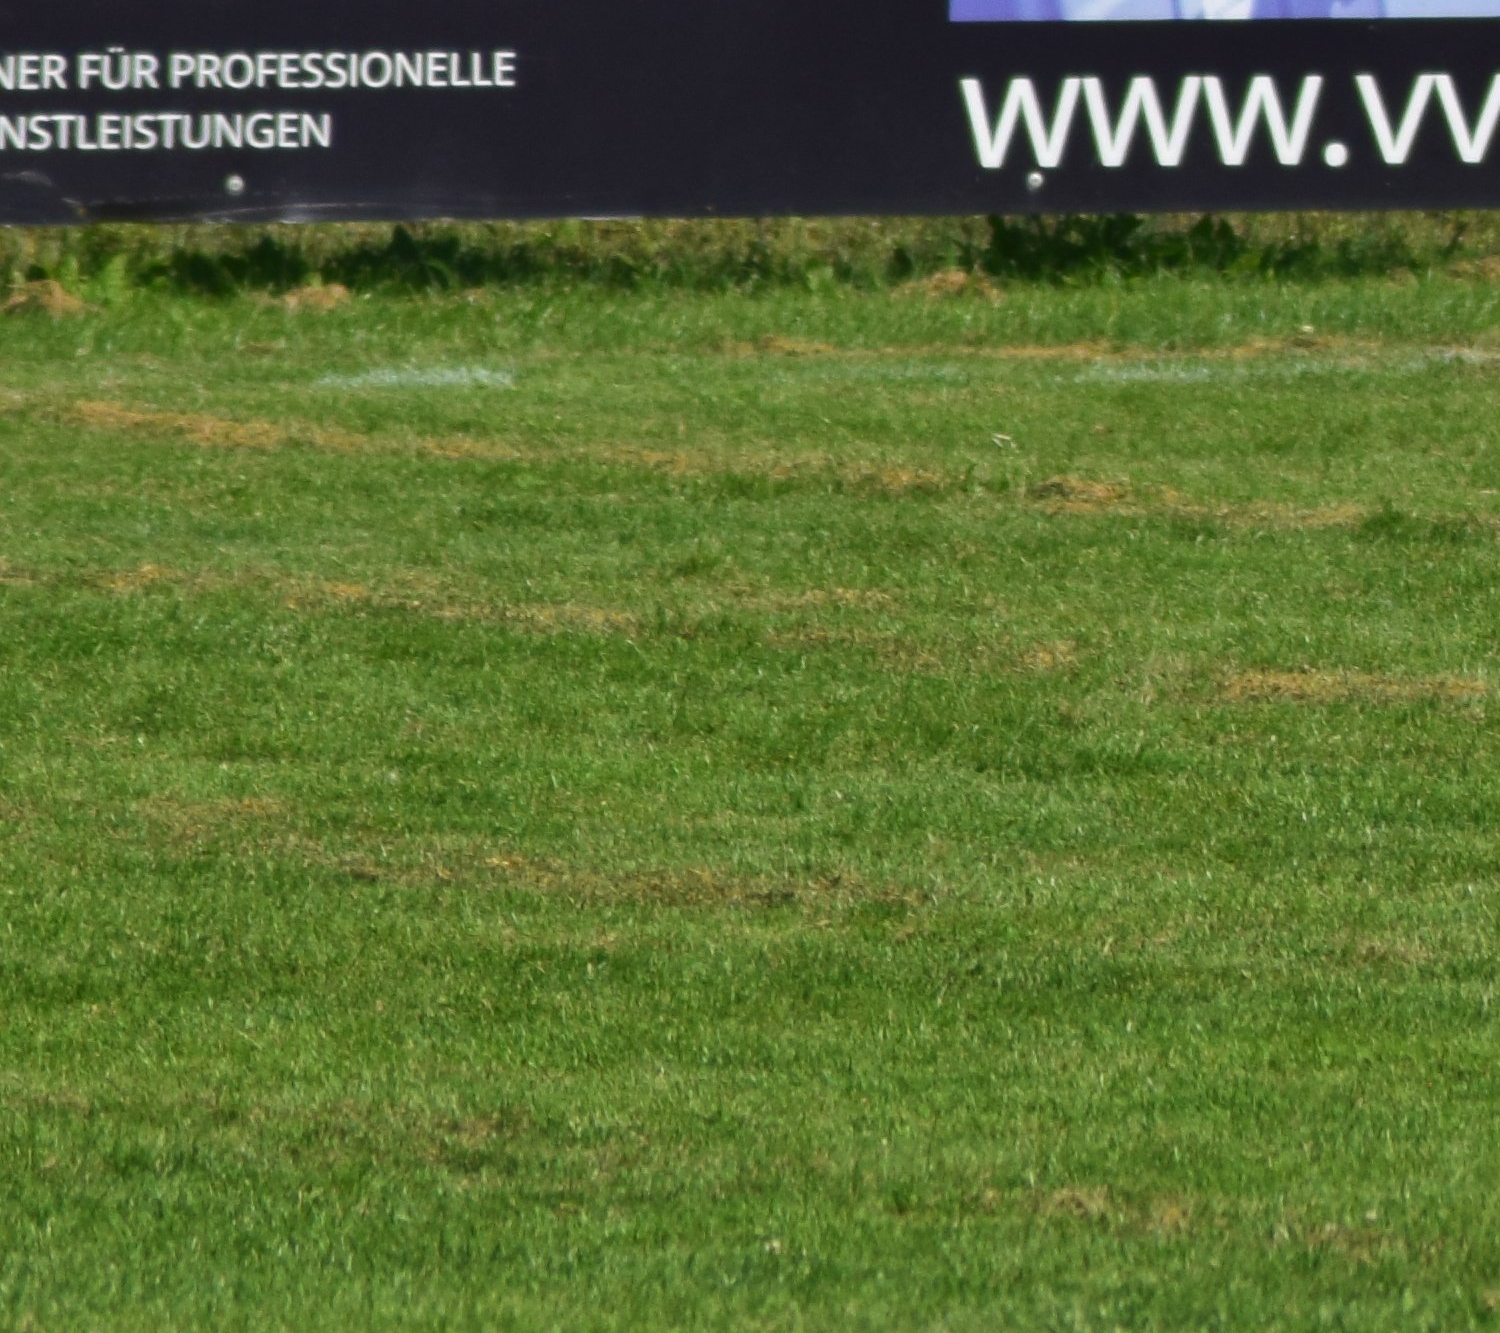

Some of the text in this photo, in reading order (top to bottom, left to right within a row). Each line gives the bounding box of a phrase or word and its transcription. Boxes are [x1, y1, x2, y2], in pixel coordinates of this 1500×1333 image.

[77, 46, 159, 90] FÜR
[168, 51, 516, 89] PROFESSIONELLE
[0, 112, 331, 150] NSTLEISTUNGEN
